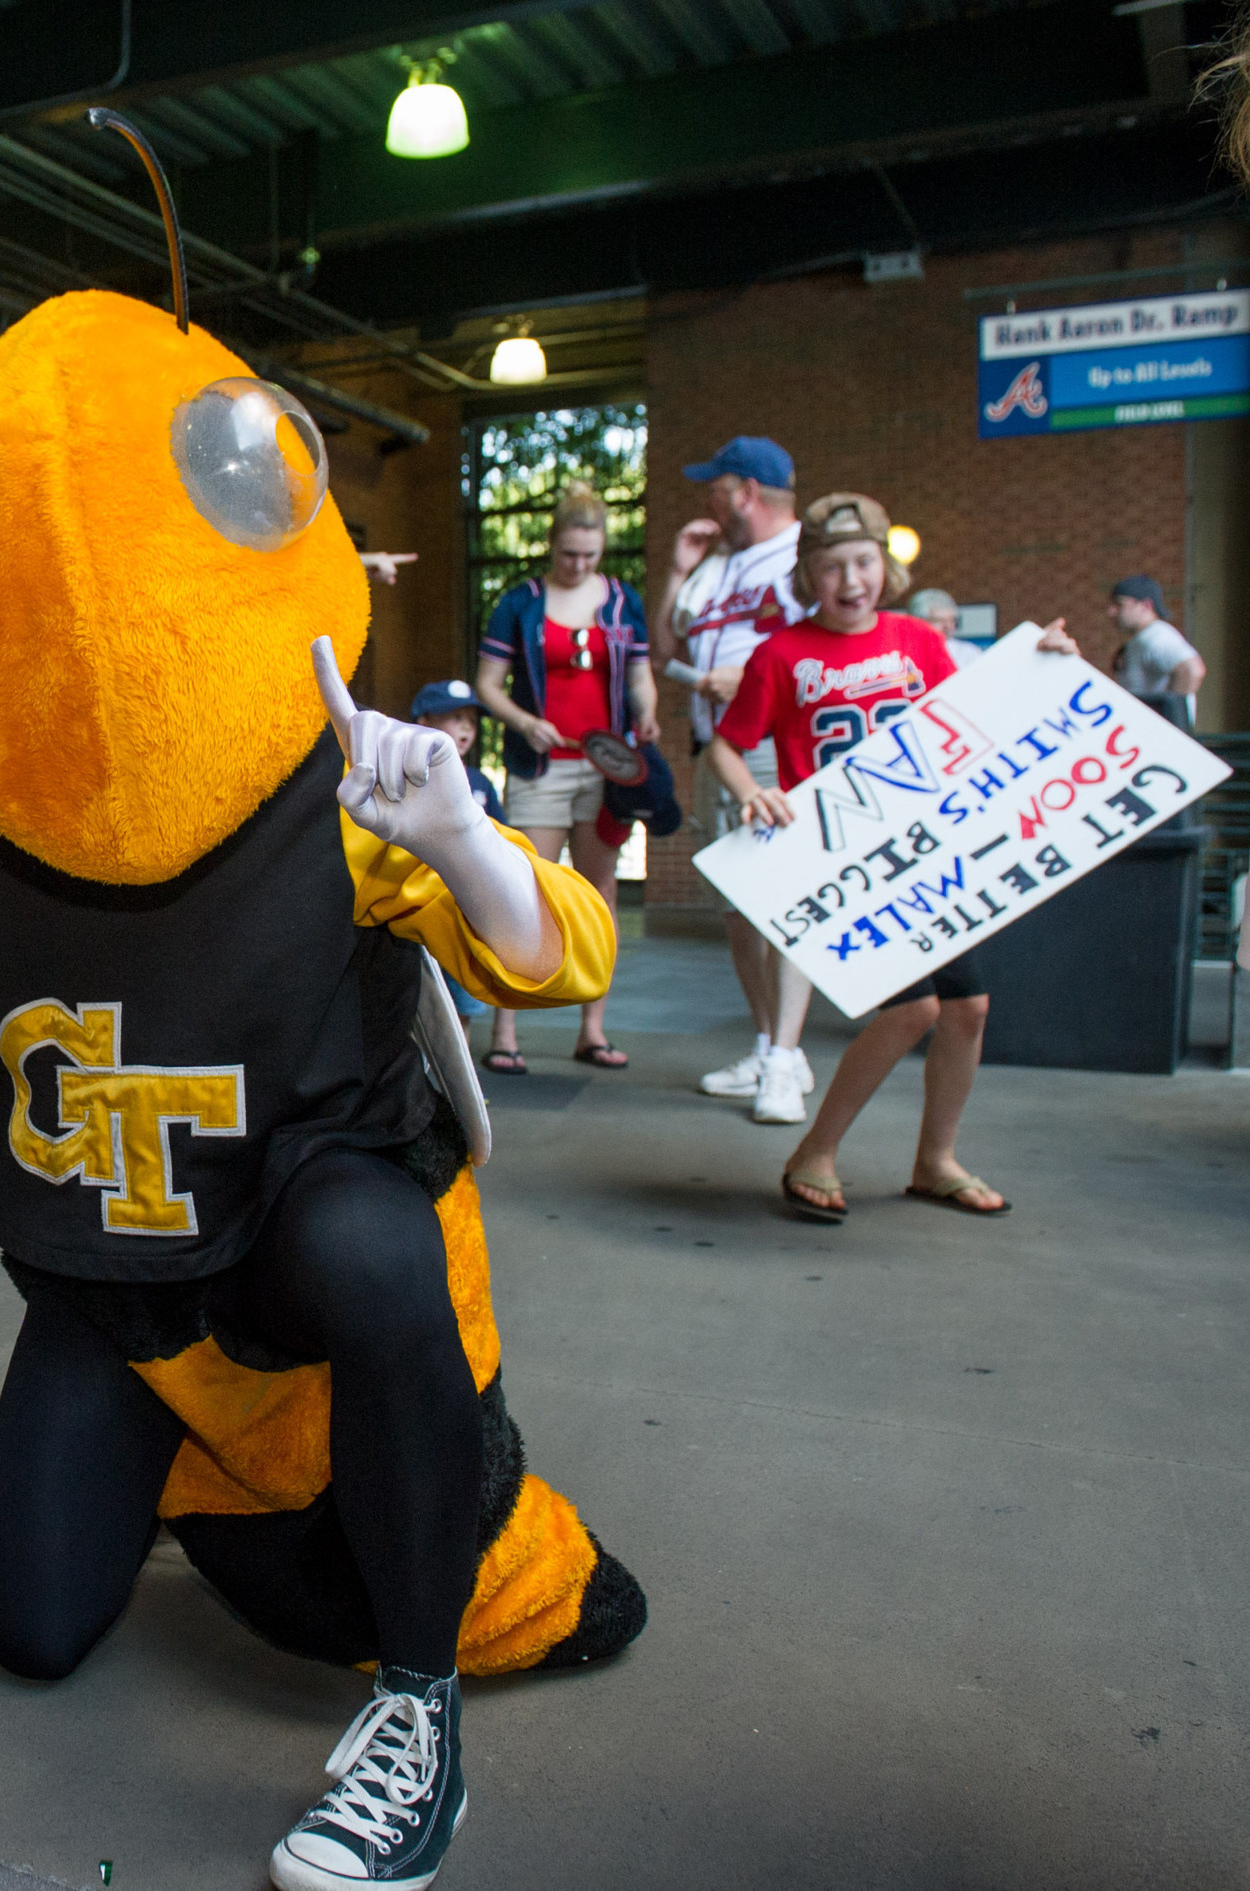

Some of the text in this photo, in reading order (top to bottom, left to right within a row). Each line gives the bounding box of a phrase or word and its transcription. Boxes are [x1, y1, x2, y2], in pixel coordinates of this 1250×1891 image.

[995, 303, 1239, 346] Hank Aaron Dr. Ramp
[1160, 357, 1213, 381] Levels
[793, 650, 905, 709] Braves
[770, 680, 1113, 948] SMITH'S BIGGEST
[814, 698, 995, 853] FAN
[1019, 725, 1140, 840] SOON
[911, 765, 1188, 953] GET BETTER
